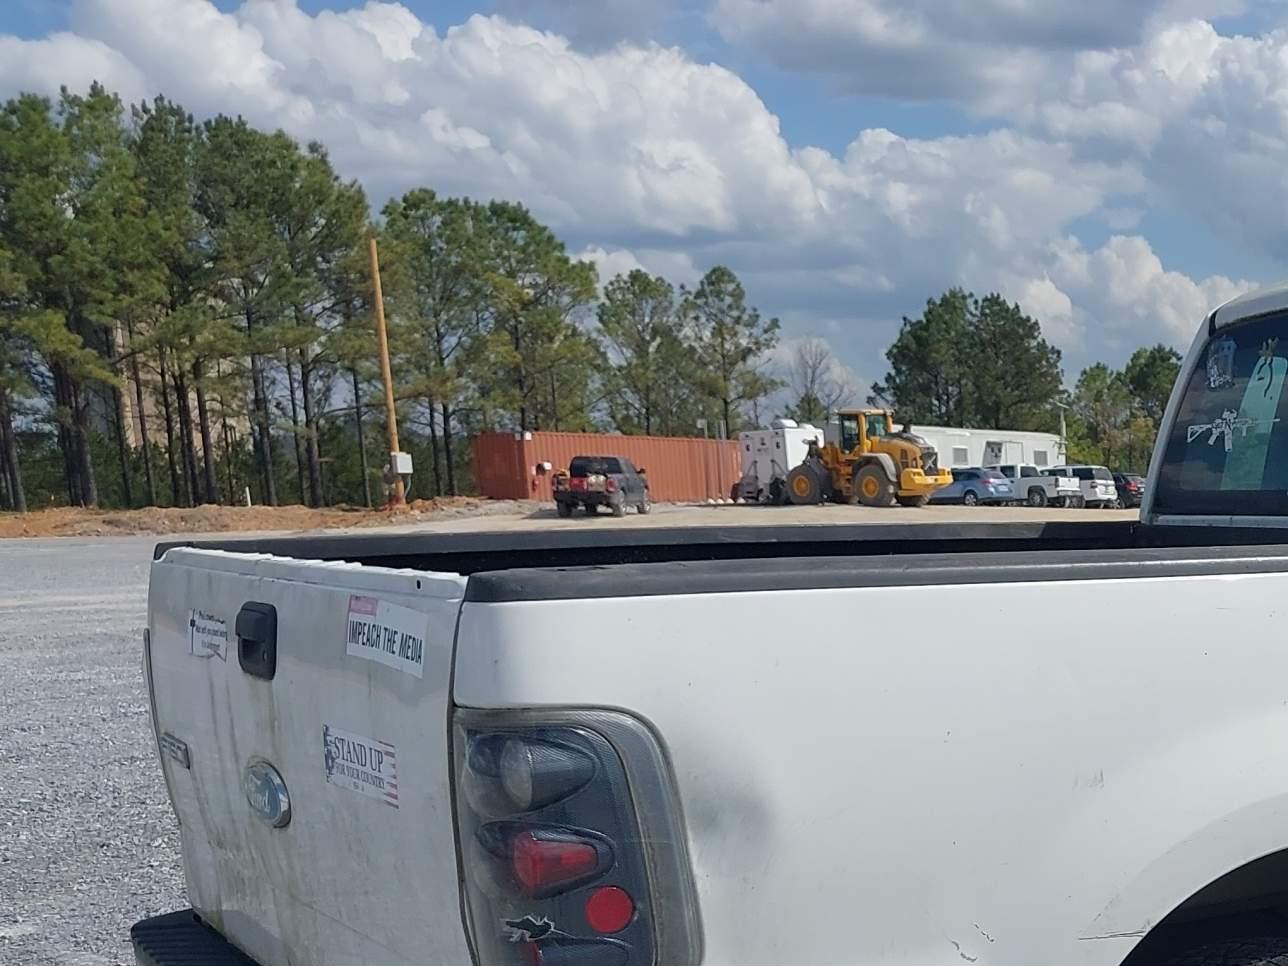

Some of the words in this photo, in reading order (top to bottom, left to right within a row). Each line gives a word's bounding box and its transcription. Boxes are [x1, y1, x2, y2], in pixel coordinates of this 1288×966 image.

[348, 619, 382, 650] IMPEACH
[383, 626, 399, 655] THE
[398, 632, 423, 665] MEDIA
[334, 736, 367, 767] STAND
[369, 747, 384, 773] UP
